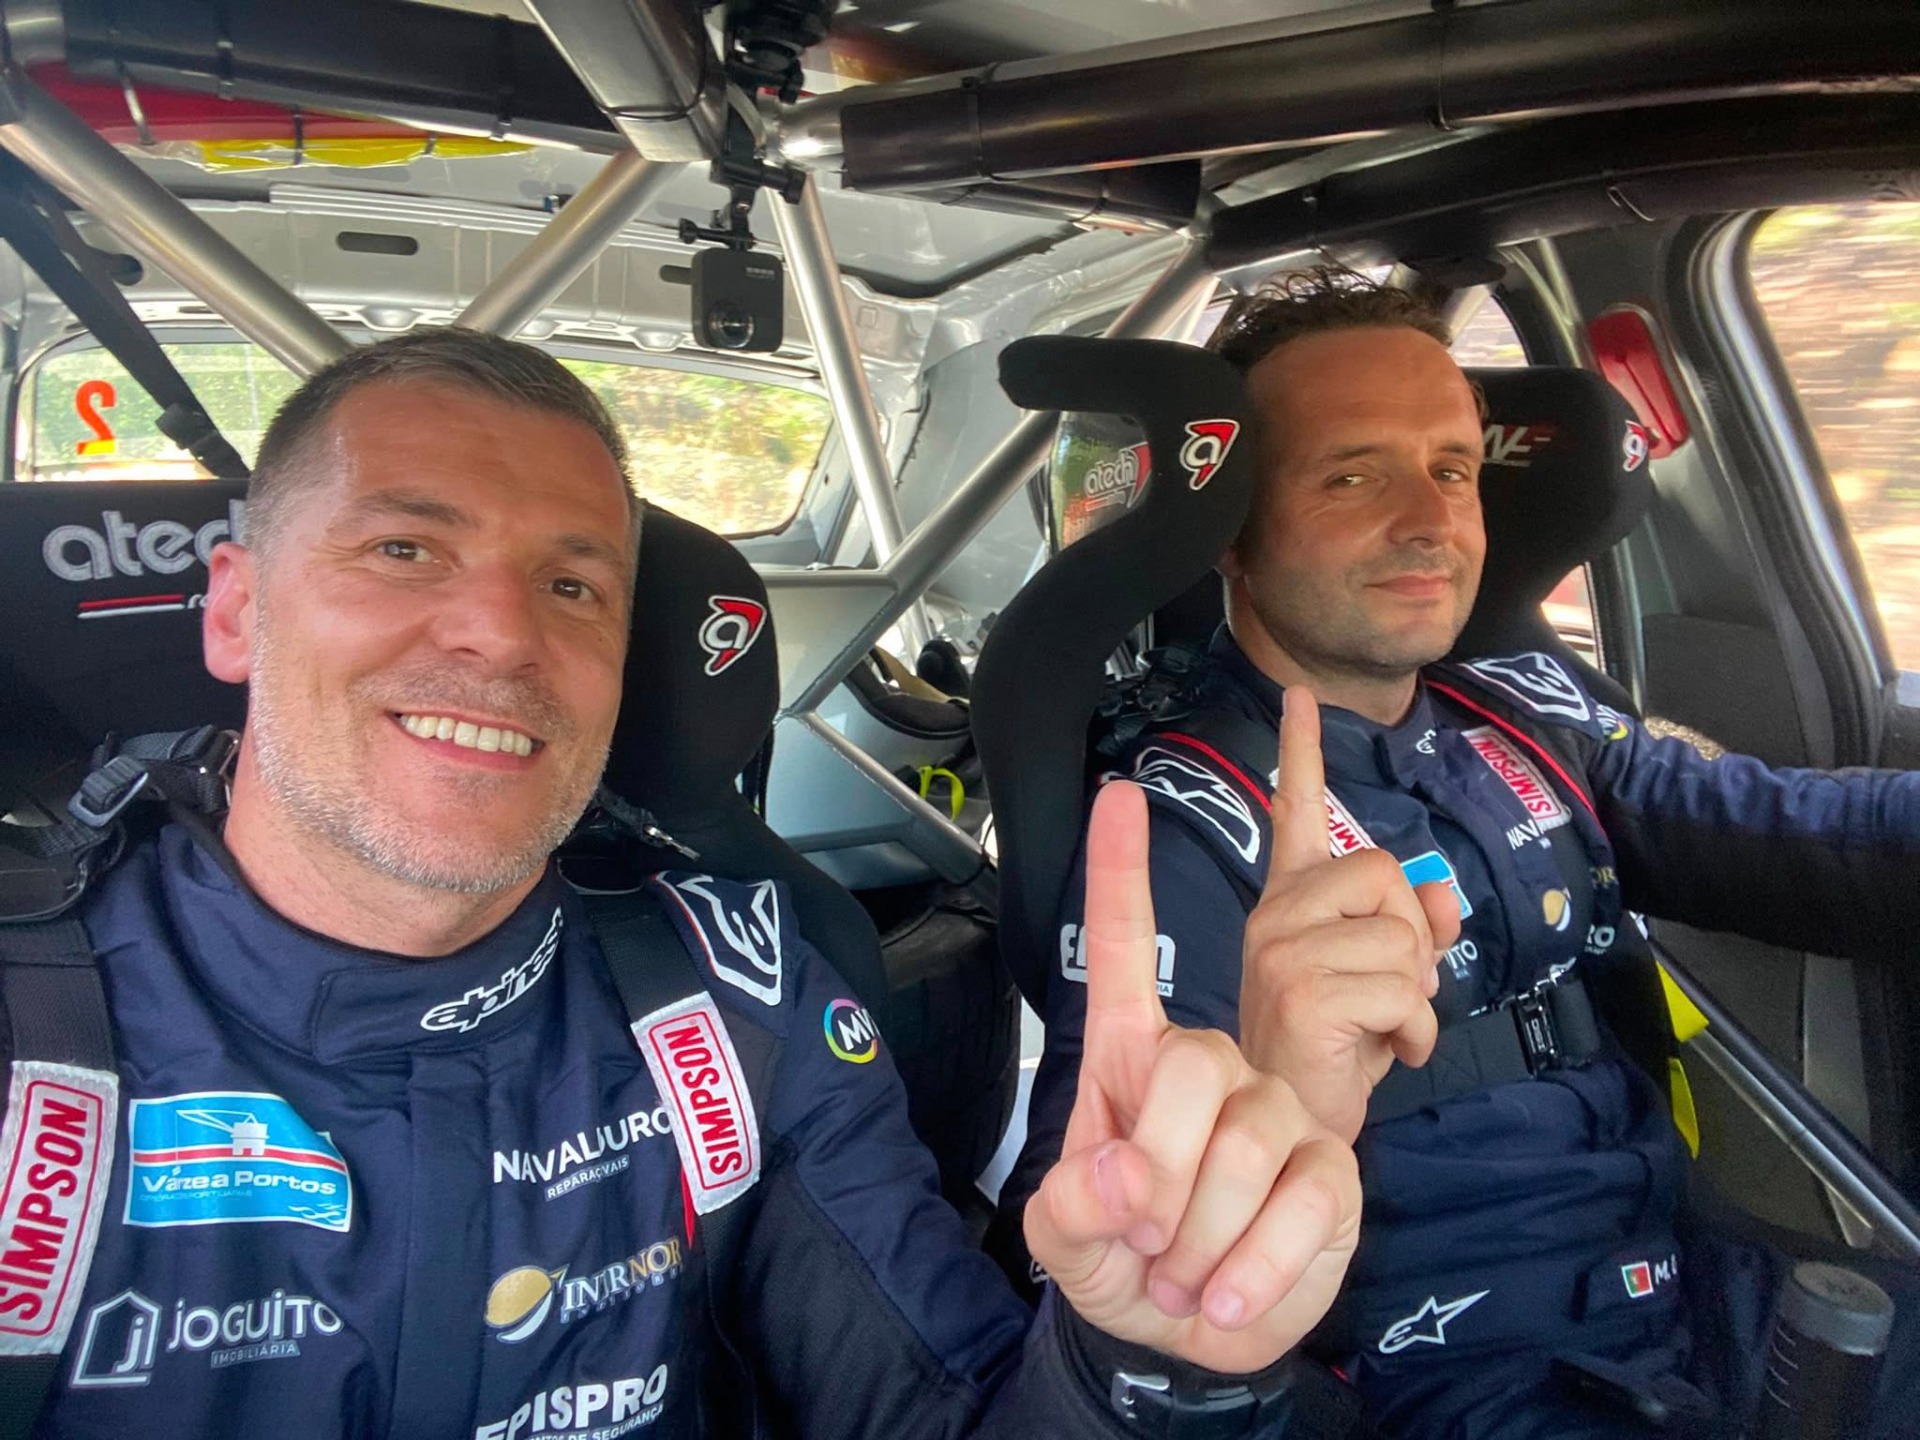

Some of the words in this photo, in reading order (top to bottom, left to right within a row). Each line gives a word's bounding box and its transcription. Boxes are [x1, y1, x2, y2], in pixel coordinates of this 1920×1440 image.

[1085, 449, 1136, 495] atech
[663, 1024, 743, 1177] SIMPSON
[0, 1098, 88, 1321] SIMPSON
[234, 1171, 336, 1195] Portos
